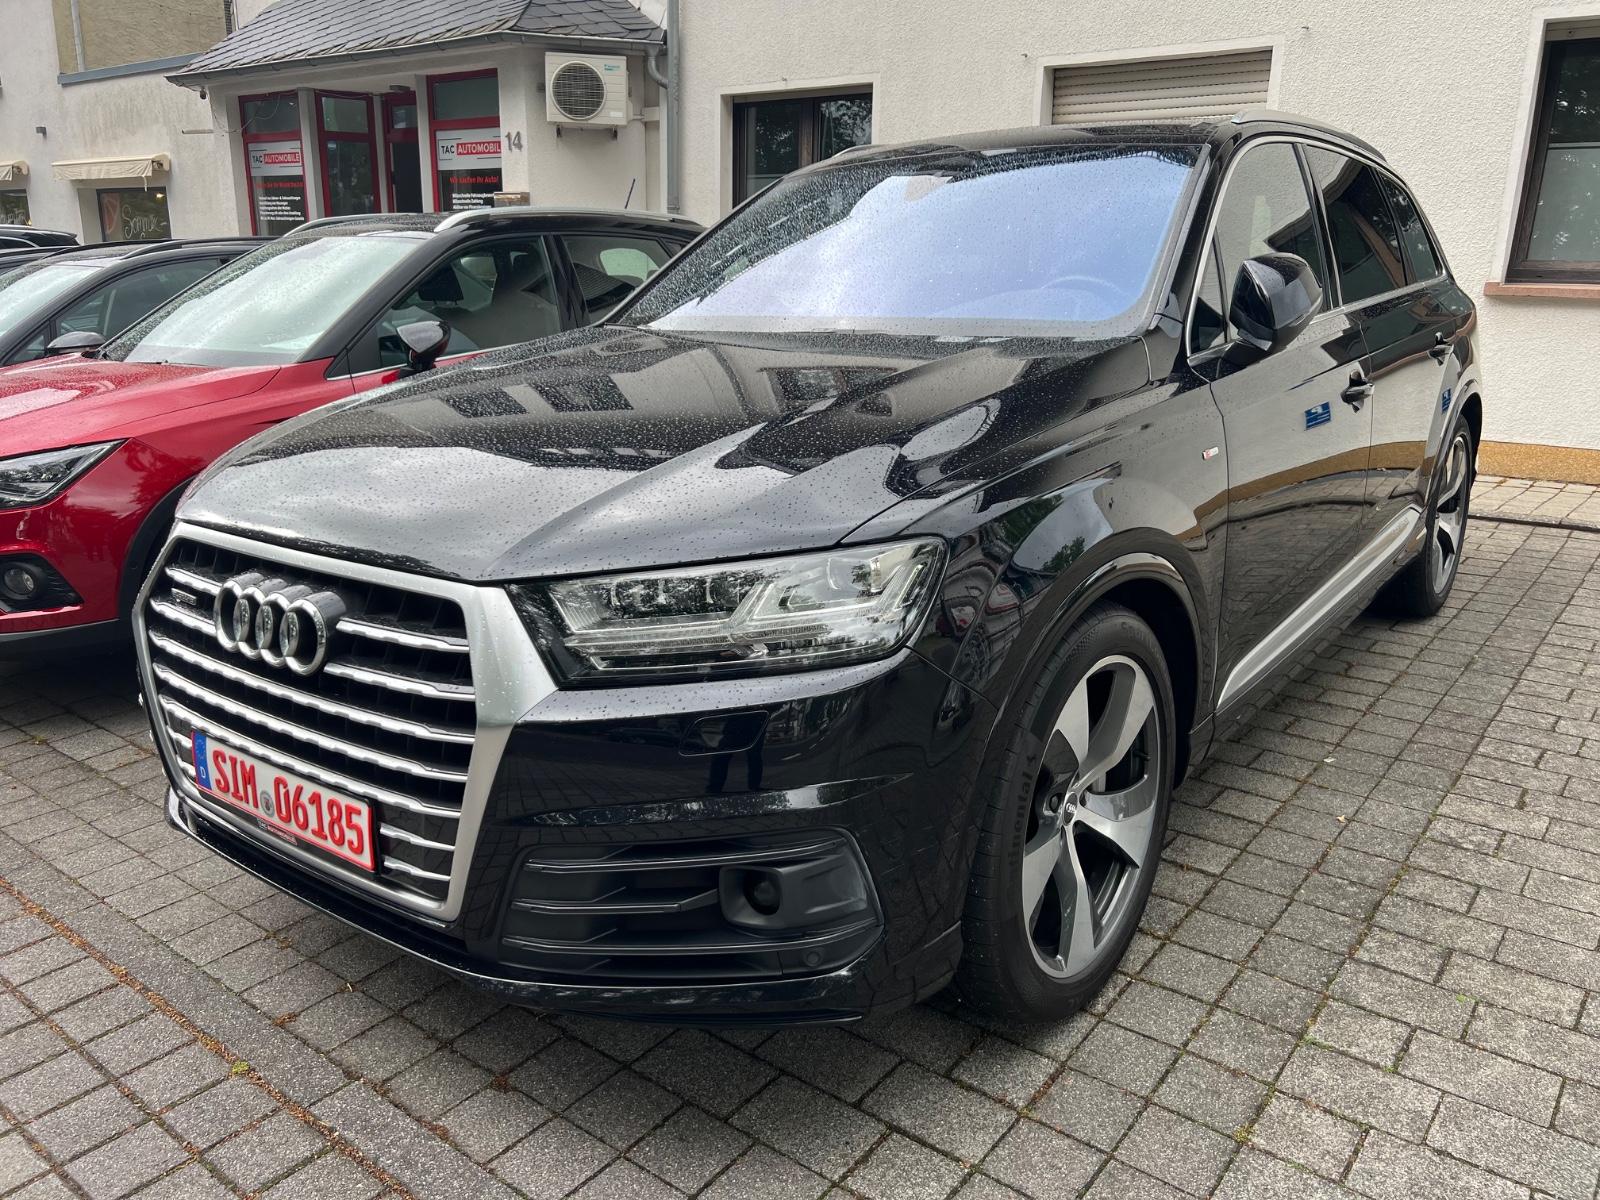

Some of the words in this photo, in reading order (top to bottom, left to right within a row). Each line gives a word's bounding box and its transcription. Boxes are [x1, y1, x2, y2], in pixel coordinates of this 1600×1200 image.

[441, 145, 455, 154] TAC
[457, 142, 501, 154] AUTOMOBIL
[504, 131, 523, 152] 14
[252, 155, 263, 164] TAC
[264, 153, 300, 163] AUTOMOBILE
[199, 766, 206, 779] D
[212, 750, 259, 809] SIM
[273, 776, 364, 855] 06185
